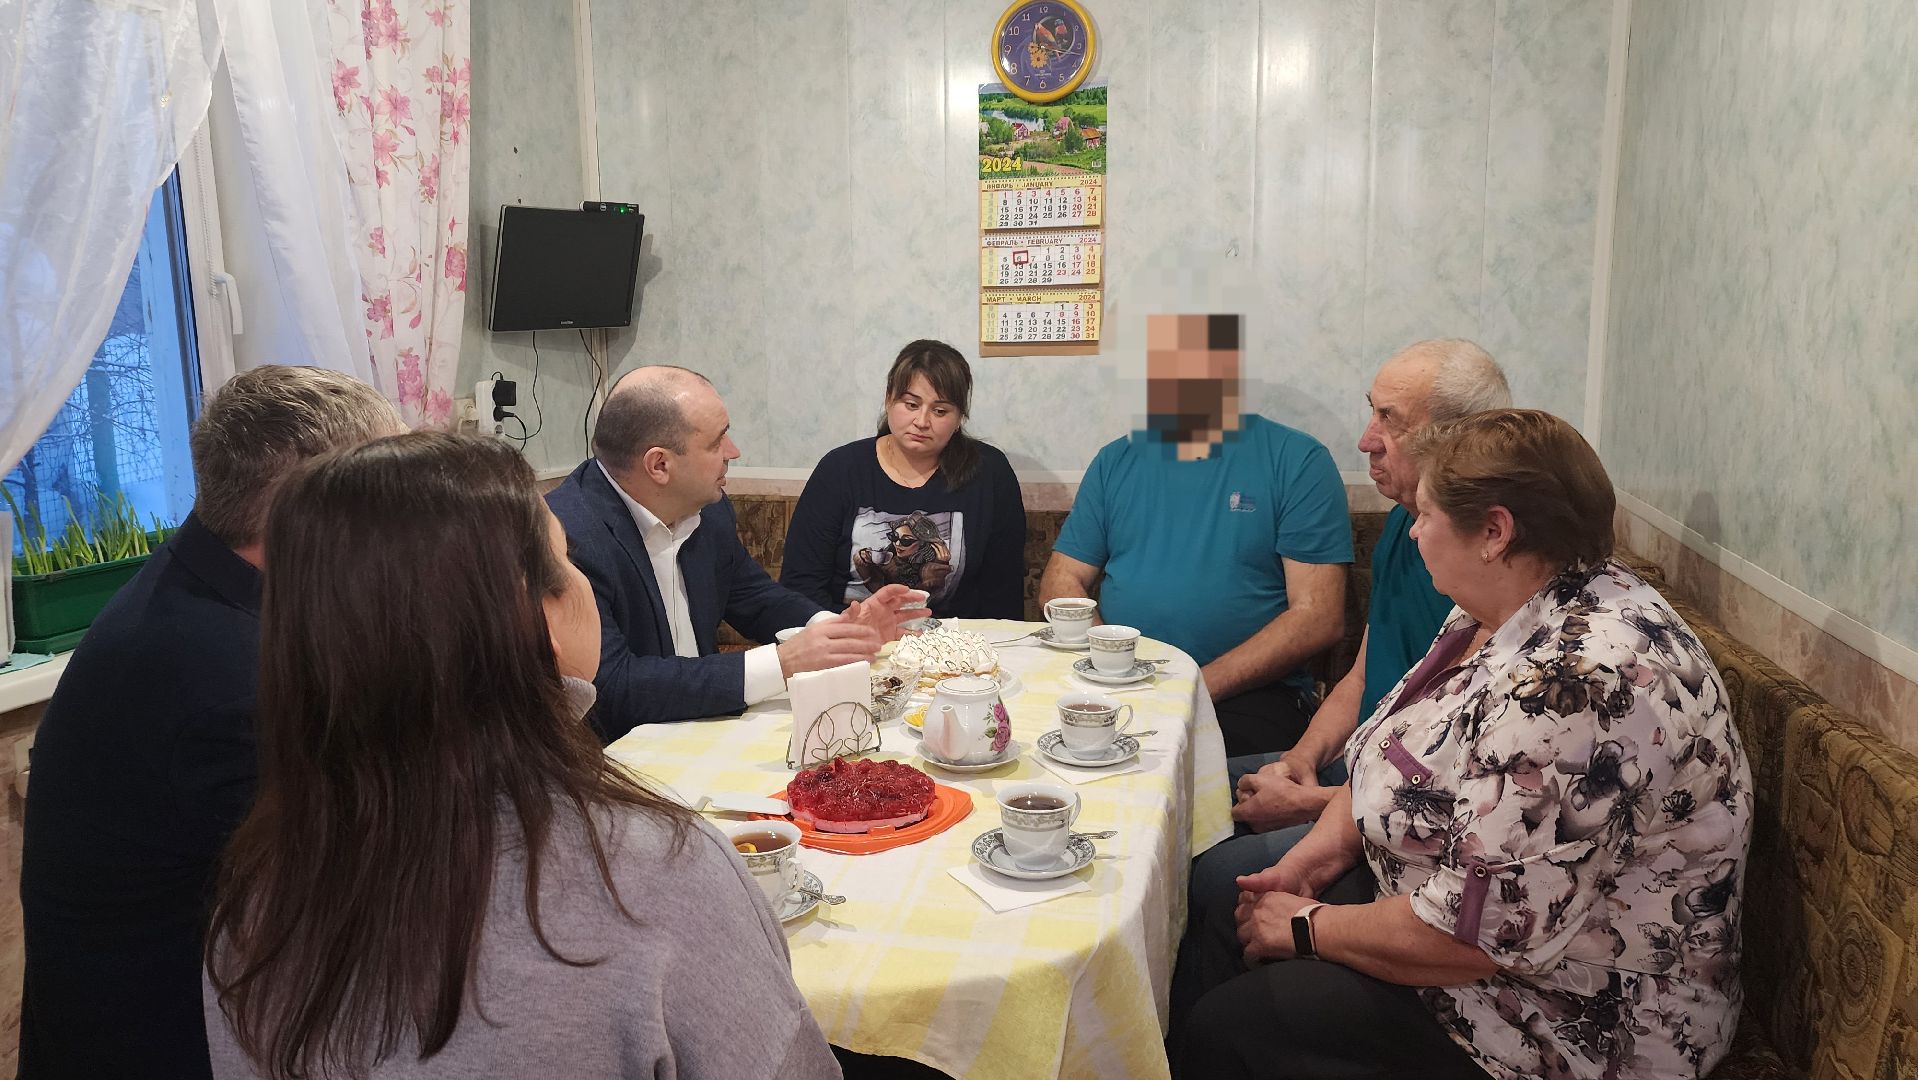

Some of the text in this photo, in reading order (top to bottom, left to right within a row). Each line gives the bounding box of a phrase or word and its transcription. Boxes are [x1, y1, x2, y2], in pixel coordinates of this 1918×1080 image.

[1022, 13, 1030, 21] 11
[1009, 26, 1019, 35] 10
[1005, 45, 1011, 56] 9
[1010, 63, 1017, 74] 8
[1024, 75, 1030, 86] 7
[1040, 80, 1046, 88] 6
[982, 157, 1022, 172] 2024
